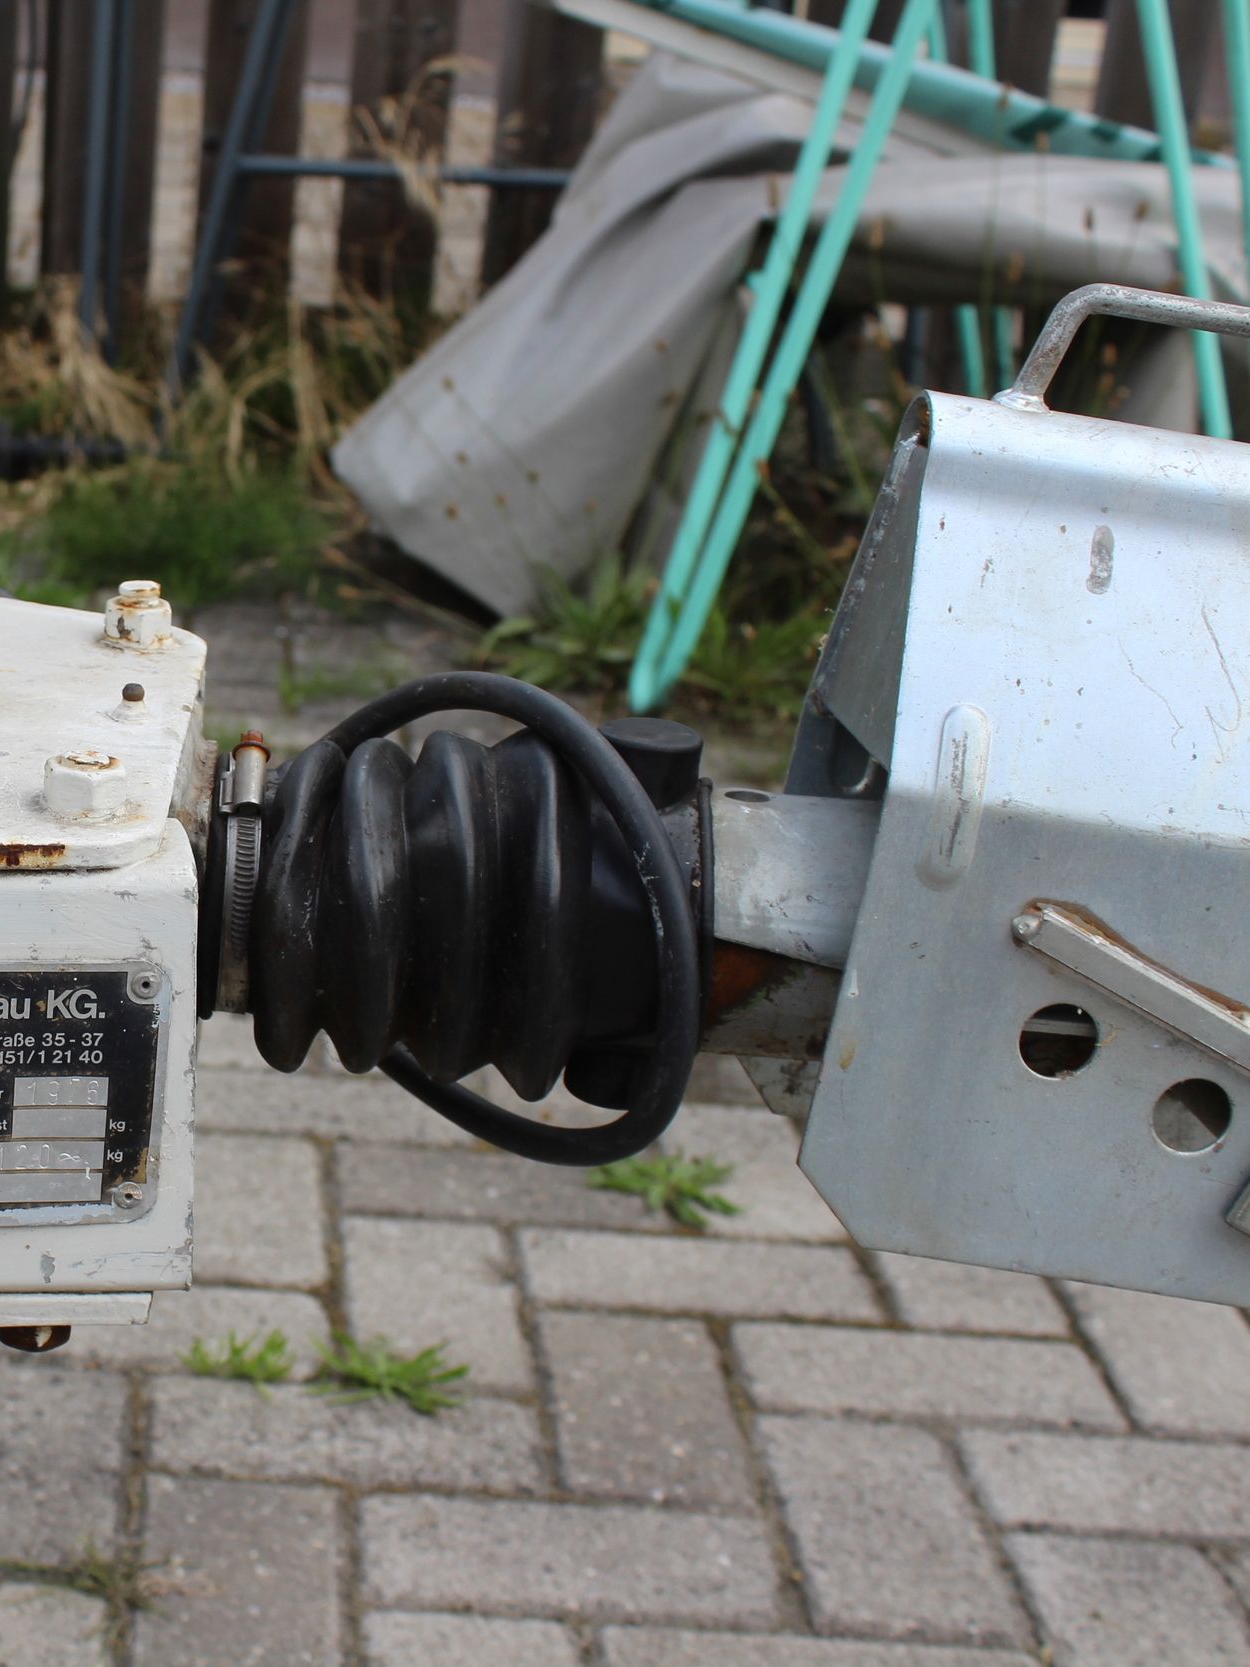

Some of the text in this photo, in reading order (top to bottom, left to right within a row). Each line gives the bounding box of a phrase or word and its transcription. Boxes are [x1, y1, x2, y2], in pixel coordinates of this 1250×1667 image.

[46, 989, 106, 1020] KG.
[41, 1032, 66, 1047] 35
[81, 1032, 104, 1047] 37
[52, 1050, 72, 1064] 21
[78, 1050, 103, 1064] 40
[109, 1118, 126, 1132] kg
[106, 1149, 124, 1163] kg
